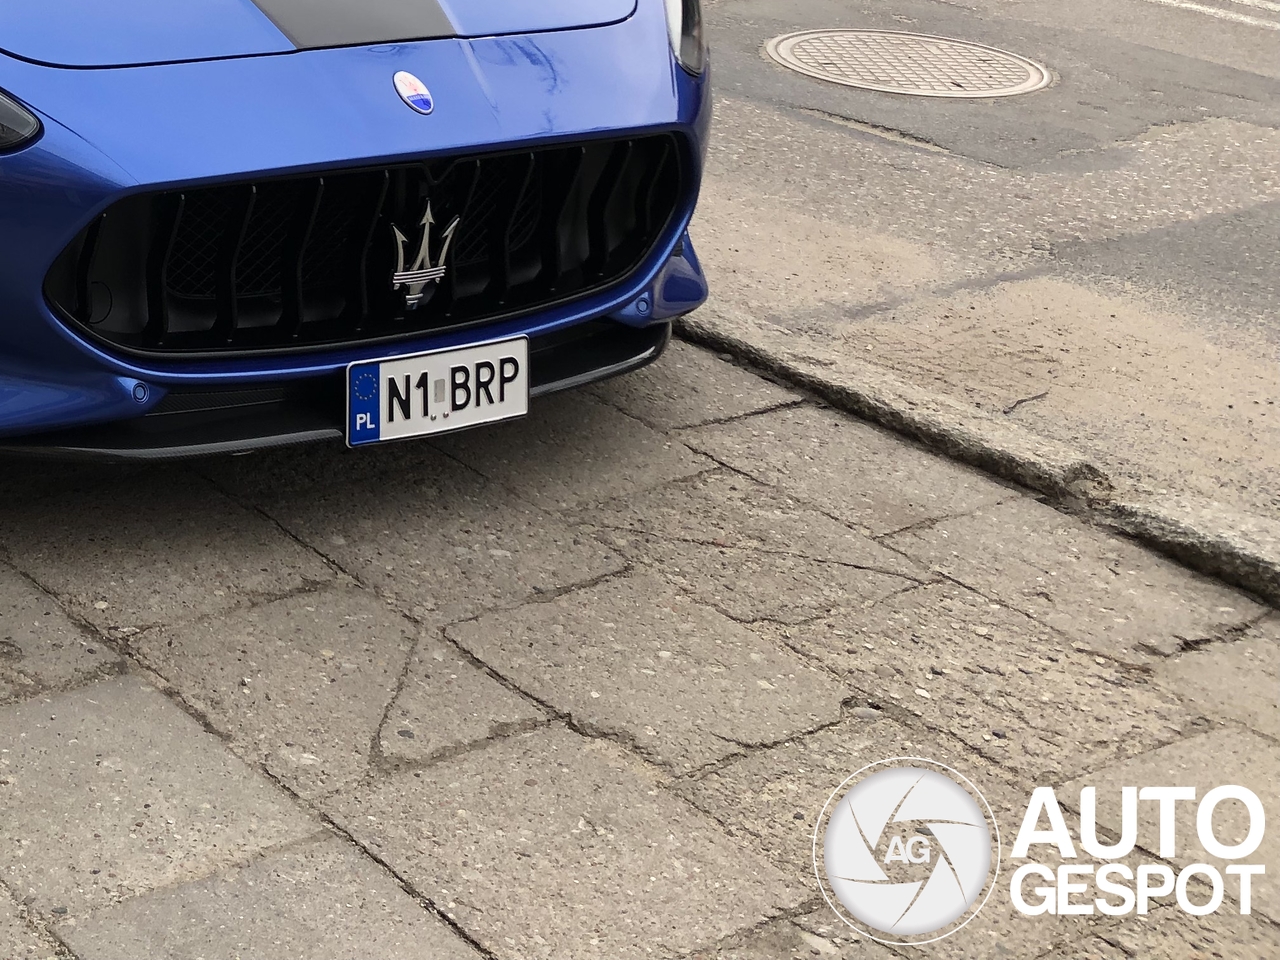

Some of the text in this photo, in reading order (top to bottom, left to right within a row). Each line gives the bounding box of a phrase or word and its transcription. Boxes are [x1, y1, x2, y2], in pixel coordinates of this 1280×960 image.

[387, 355, 520, 424] N1 BRP
[356, 412, 376, 431] PL
